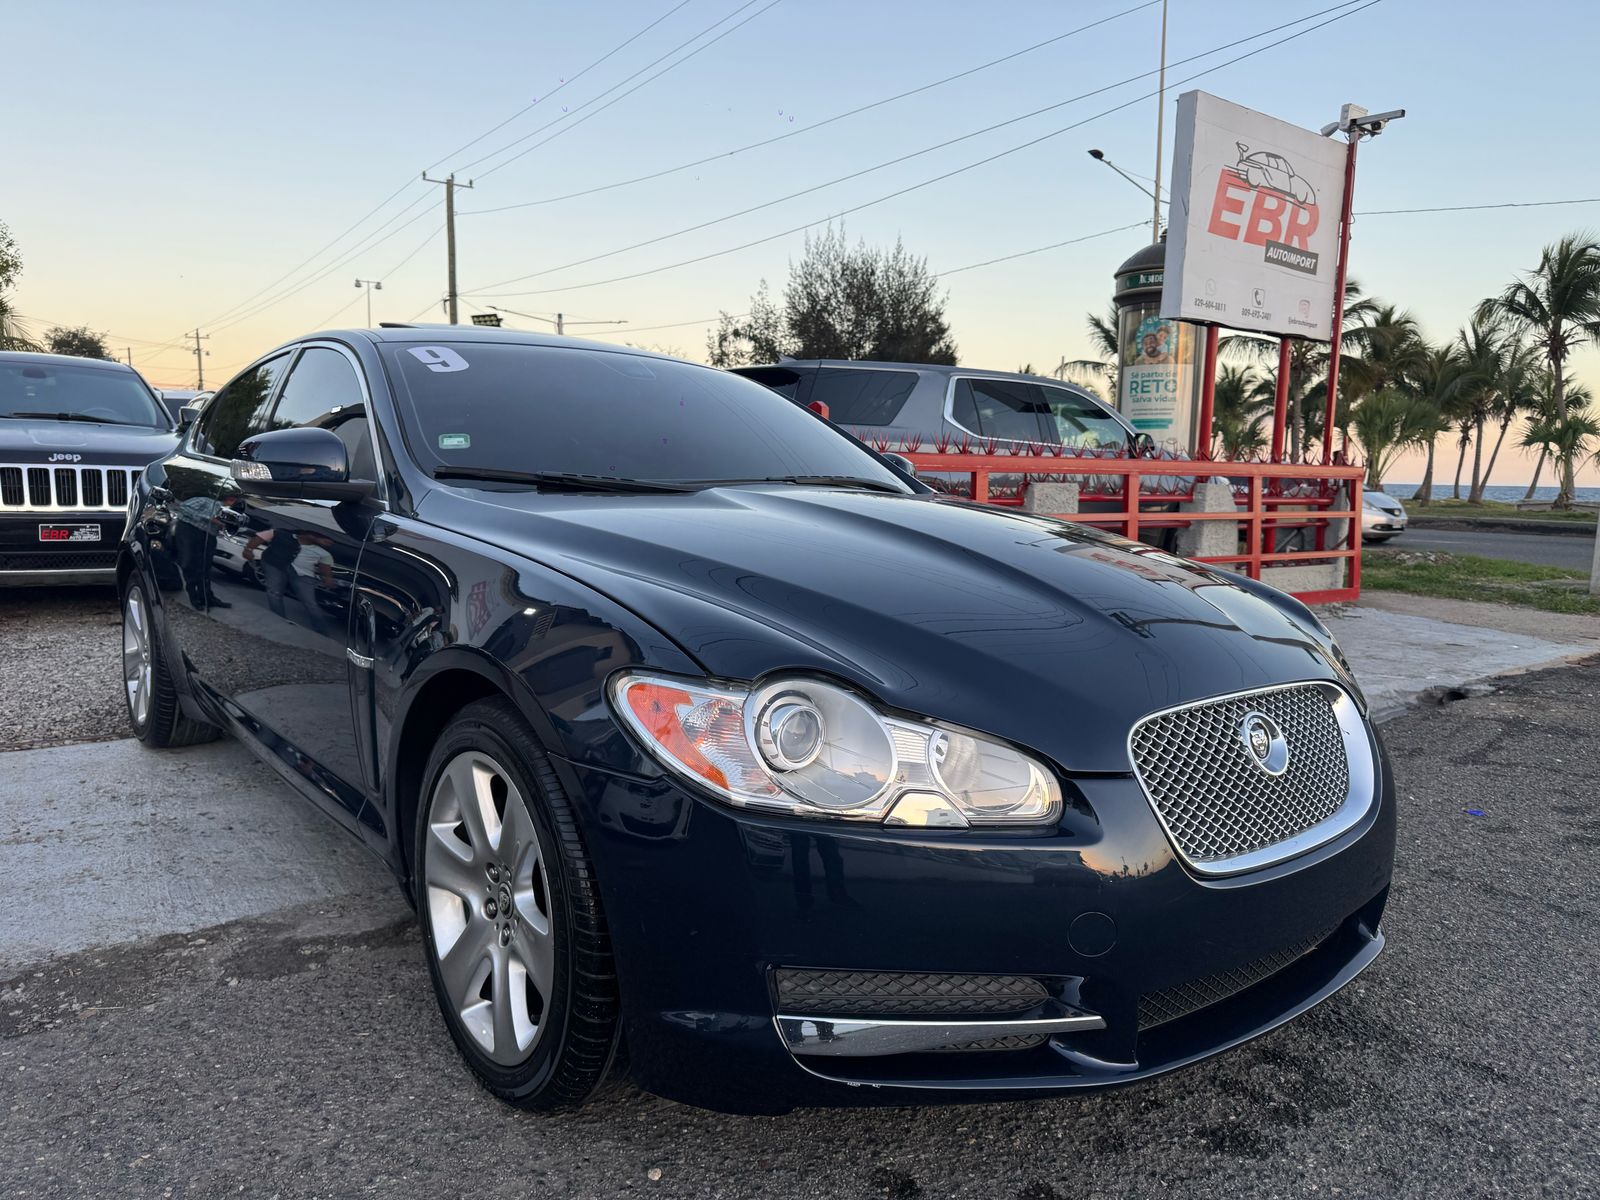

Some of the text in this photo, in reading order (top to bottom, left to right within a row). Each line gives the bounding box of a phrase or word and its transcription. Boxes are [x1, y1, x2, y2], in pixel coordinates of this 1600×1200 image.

[1207, 168, 1320, 251] EBR
[1266, 247, 1318, 270] AUTOIMPORT
[406, 345, 470, 373] 9
[1140, 371, 1163, 379] parte
[1129, 379, 1177, 394] RETO
[48, 453, 82, 462] Jeep
[41, 529, 69, 540] EBR
